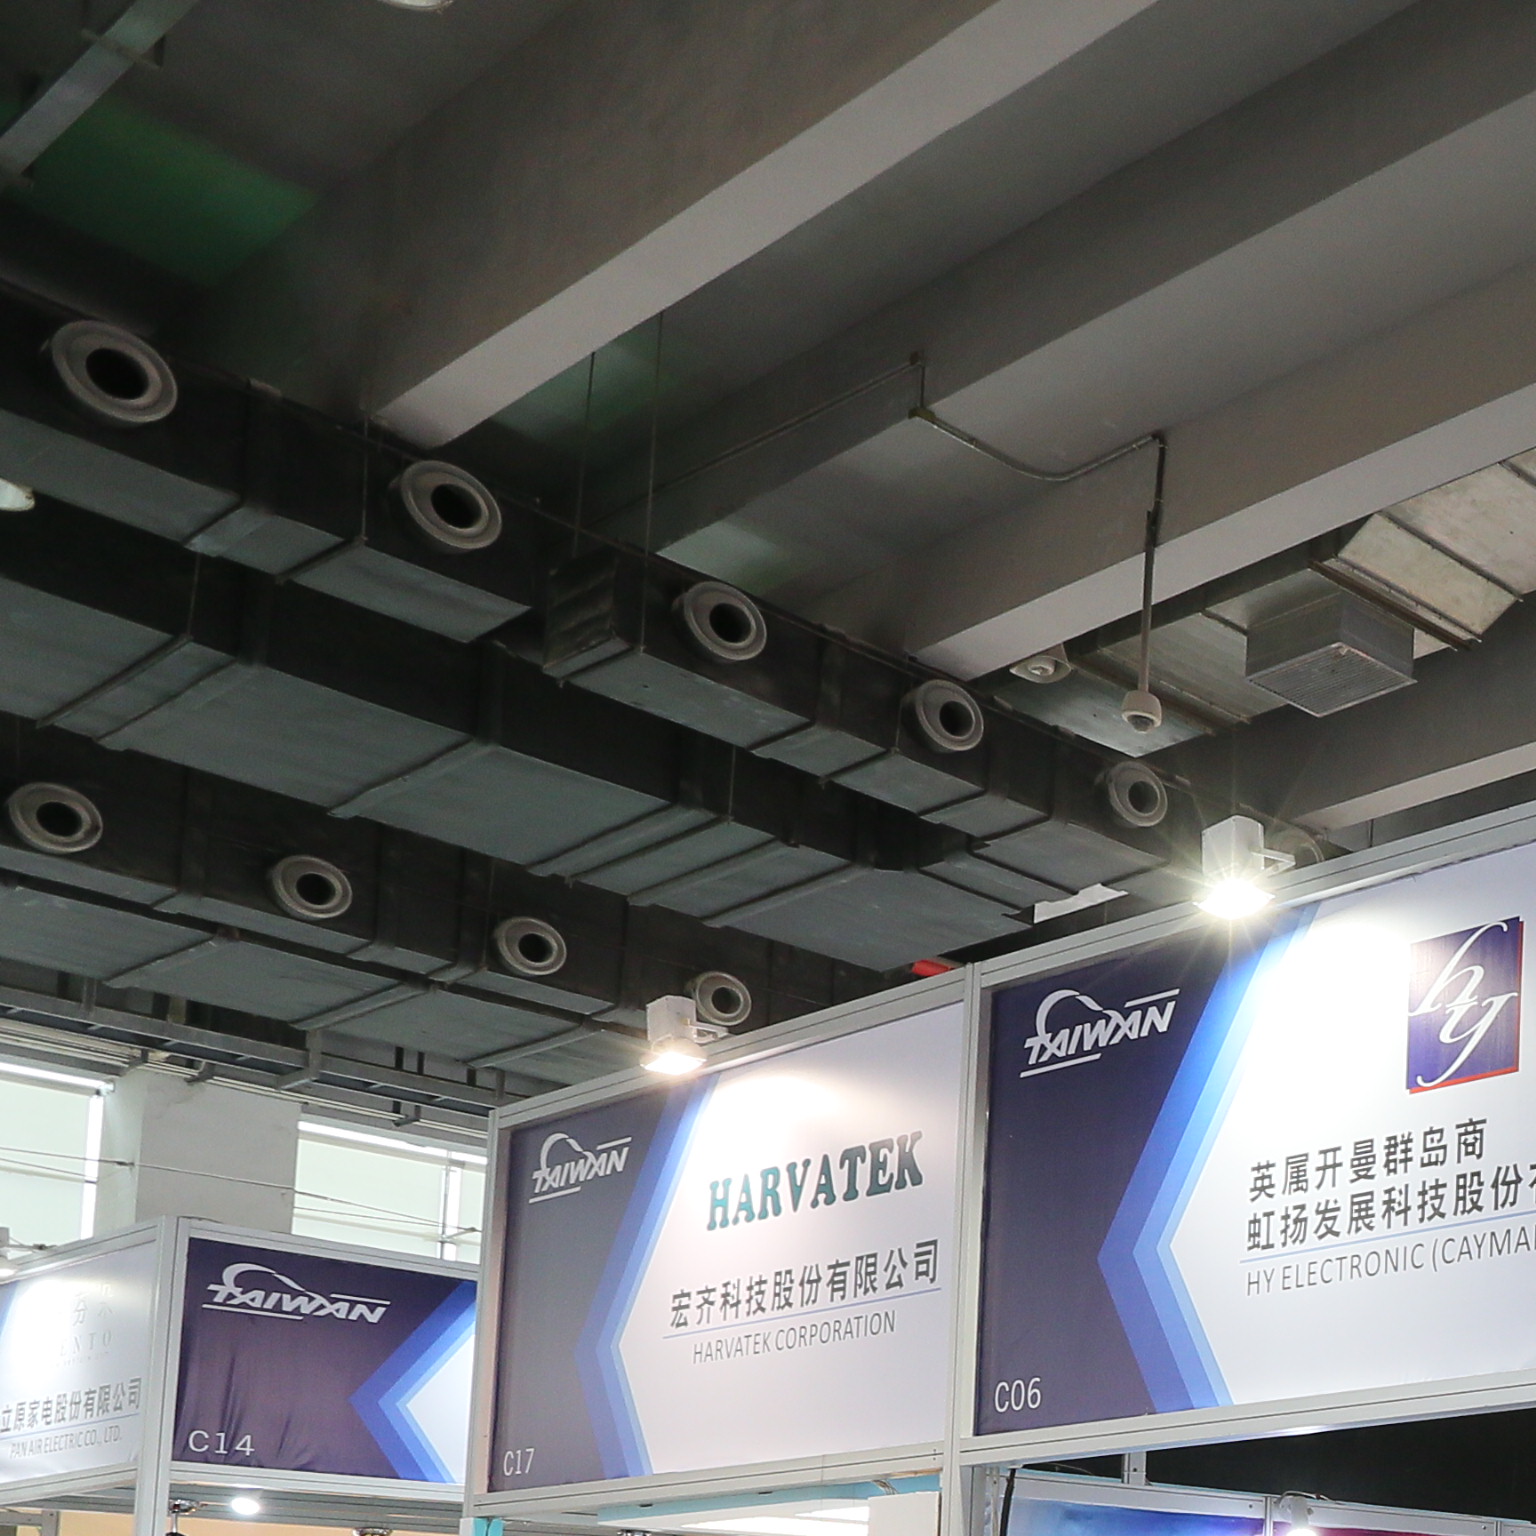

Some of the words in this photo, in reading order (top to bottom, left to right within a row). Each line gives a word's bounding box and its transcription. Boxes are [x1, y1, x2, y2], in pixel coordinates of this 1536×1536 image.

[1021, 988, 1180, 1077] TAIWAN
[529, 1132, 632, 1204] TAIWAN
[706, 1131, 925, 1231] HARVATEK
[1249, 1117, 1488, 1201] 英属开曼群岛商
[202, 1263, 391, 1325] TAIWAN
[670, 1239, 939, 1330] 宏齐科技股份有限公司
[1247, 1268, 1275, 1297] HY
[1281, 1238, 1425, 1292] ELECTRONIC
[692, 1329, 772, 1365] HARVATEK
[775, 1309, 897, 1351] CORPORATION
[994, 1376, 1043, 1413] C06
[188, 1430, 255, 1456] C14
[503, 1448, 535, 1477] C17
